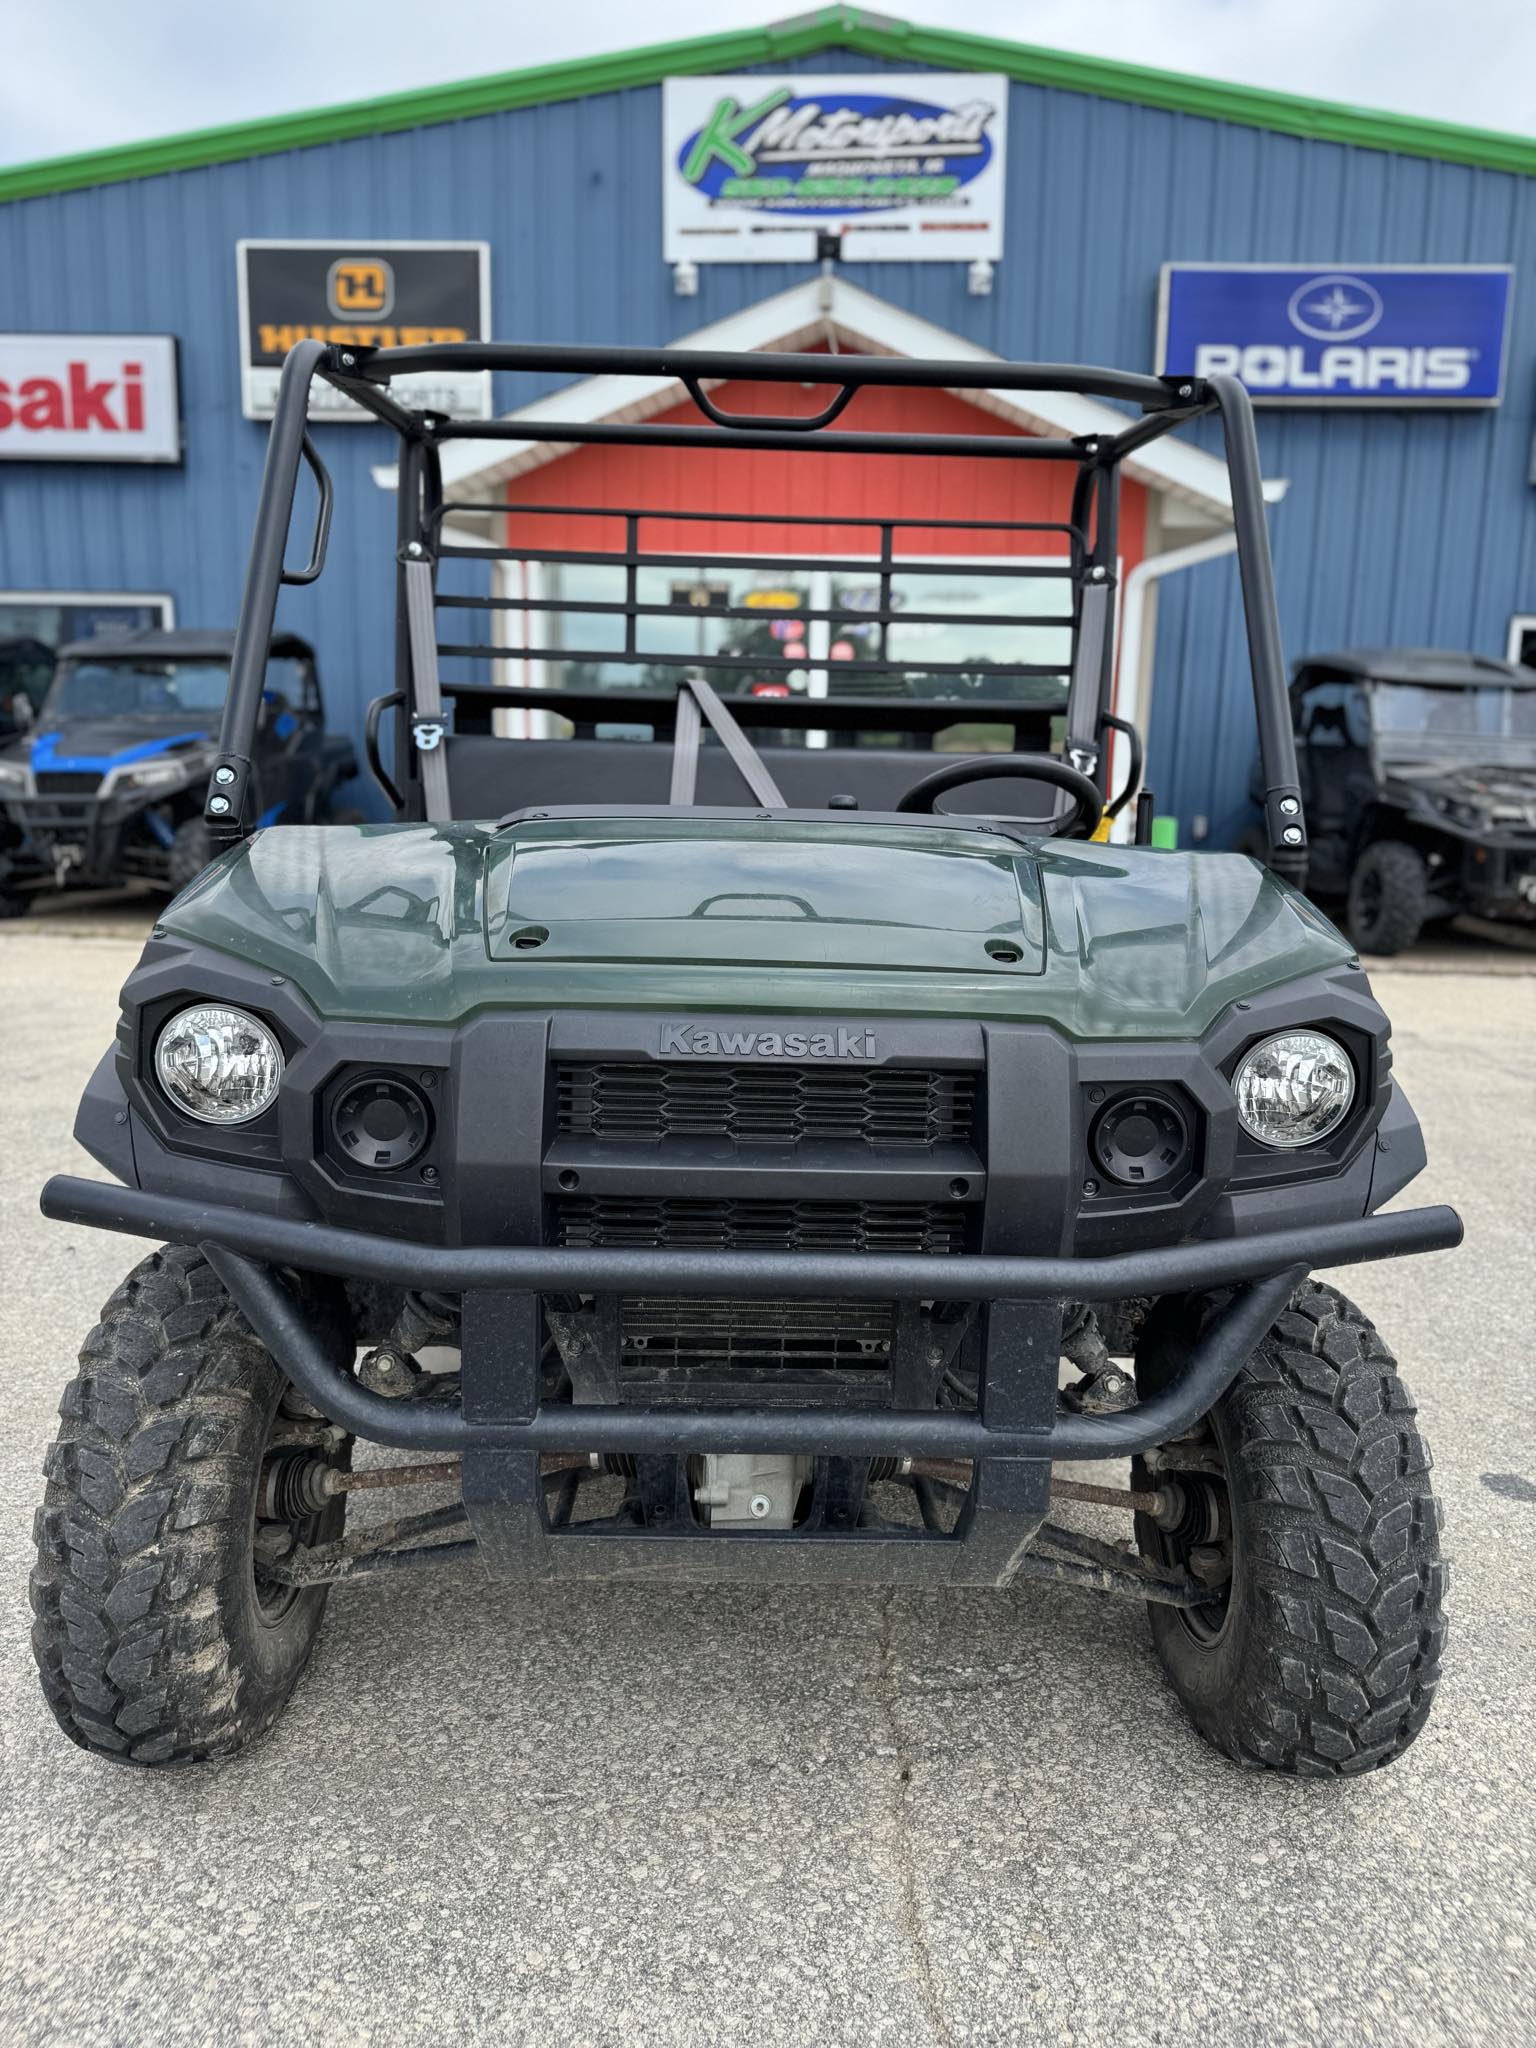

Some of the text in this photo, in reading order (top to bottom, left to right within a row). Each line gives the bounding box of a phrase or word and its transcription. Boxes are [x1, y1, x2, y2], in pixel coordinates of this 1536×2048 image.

[683, 88, 792, 182] K
[0, 360, 145, 432] aki
[1195, 344, 1471, 390] POLARIS
[658, 1022, 877, 1059] Kawasaki
